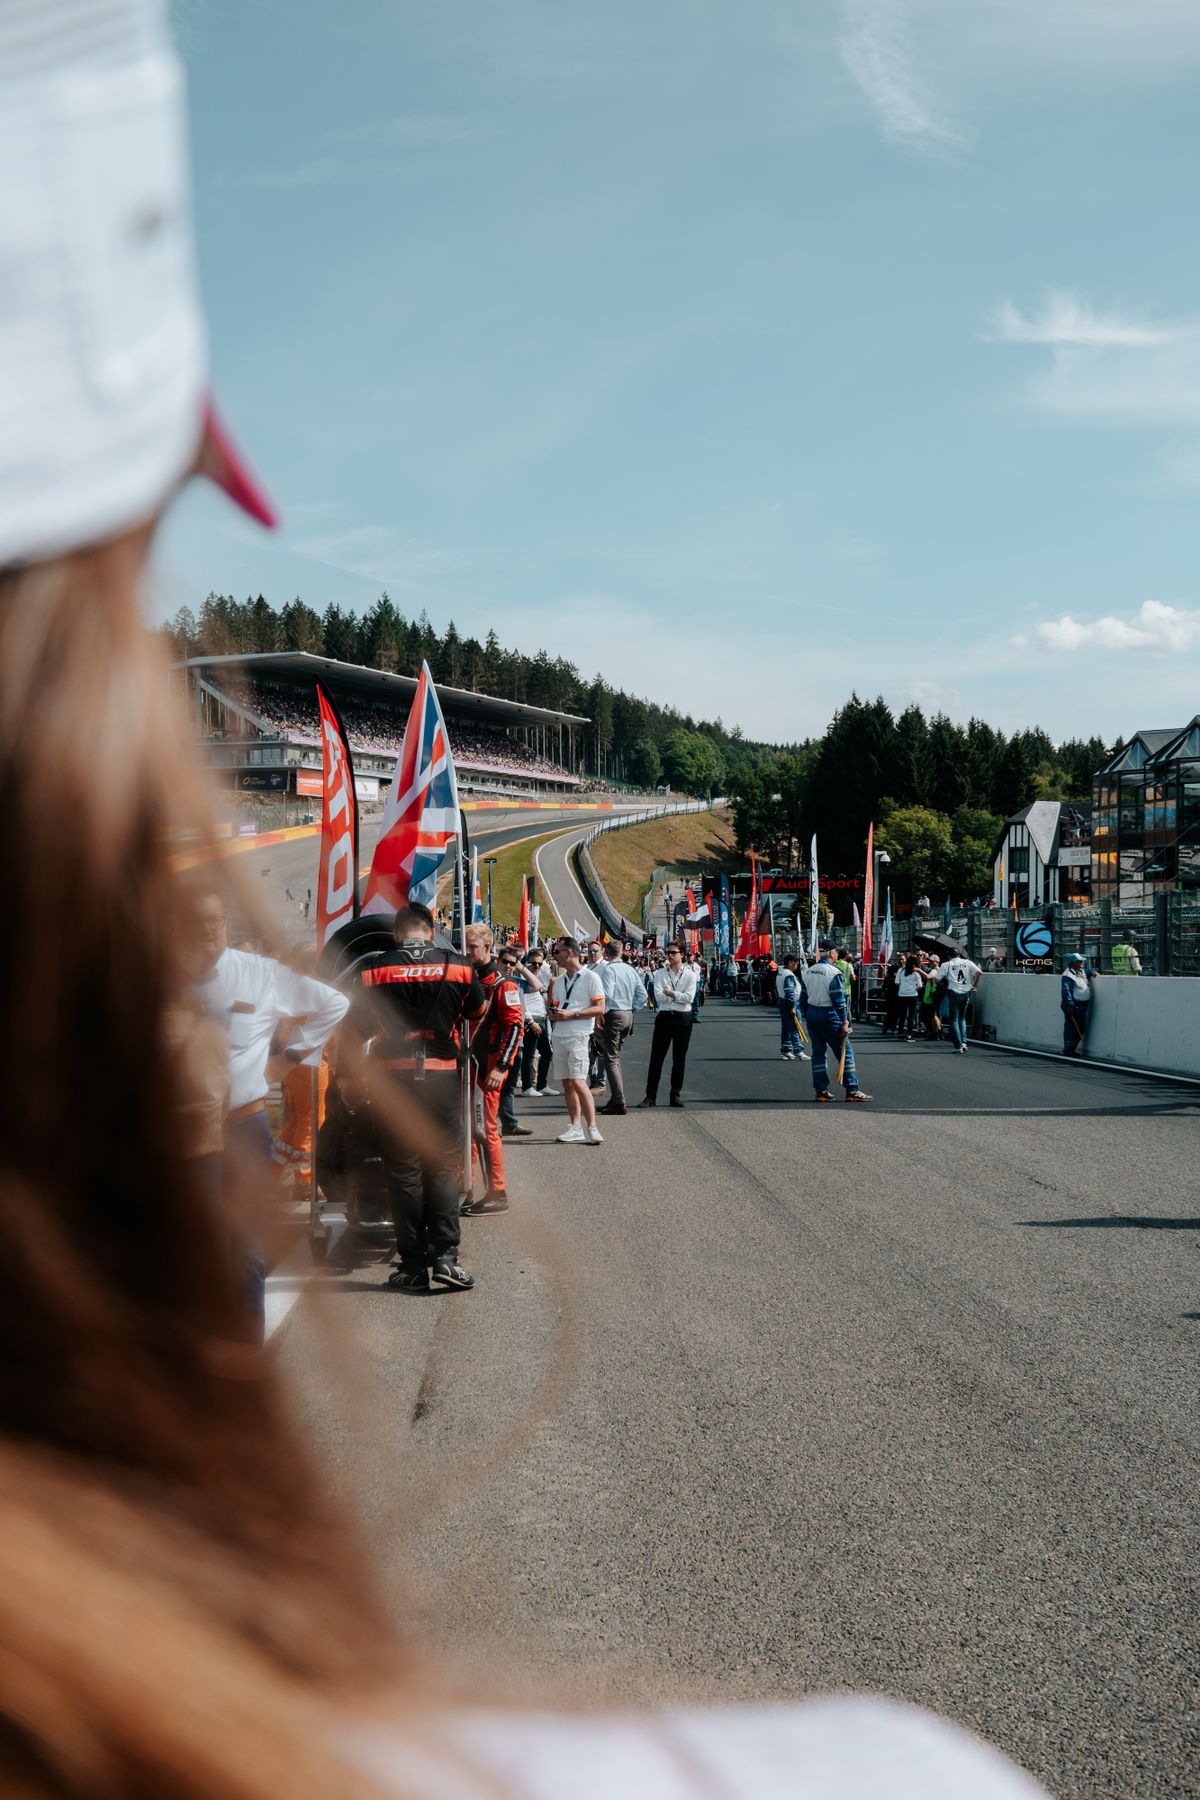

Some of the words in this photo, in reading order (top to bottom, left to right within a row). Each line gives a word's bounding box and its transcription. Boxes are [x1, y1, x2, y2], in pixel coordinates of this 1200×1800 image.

[817, 877, 860, 890] Sport
[625, 942, 631, 951] 6
[646, 939, 653, 949] 7
[1015, 958, 1053, 966] KCMG
[392, 966, 444, 978] JOTA
